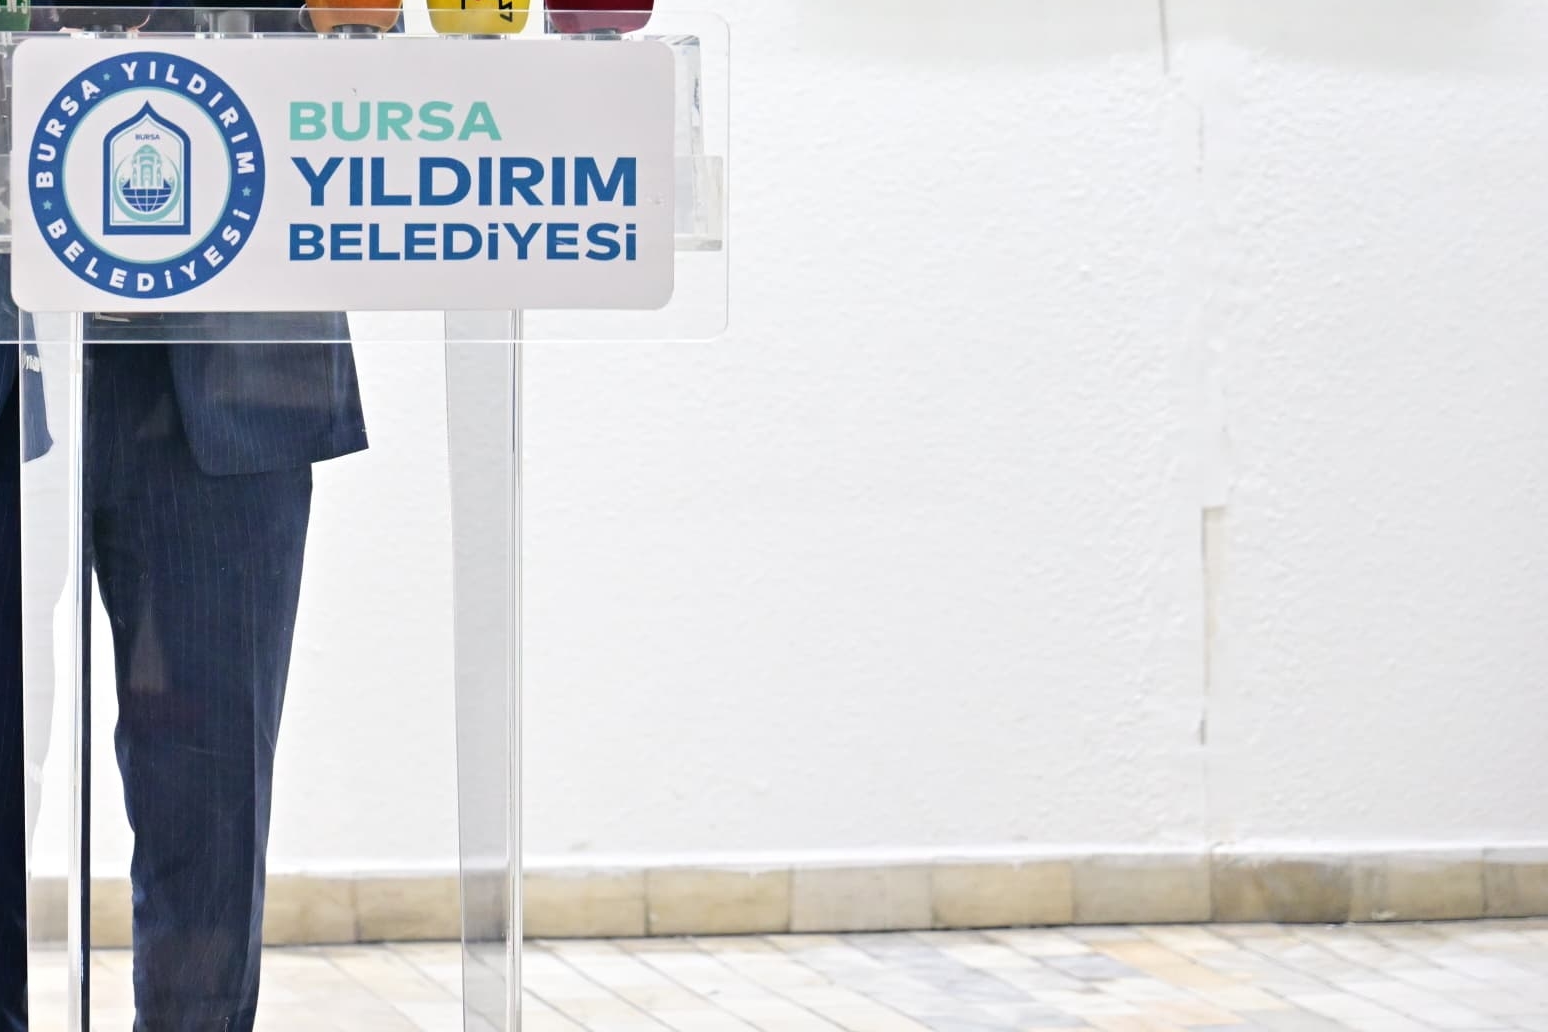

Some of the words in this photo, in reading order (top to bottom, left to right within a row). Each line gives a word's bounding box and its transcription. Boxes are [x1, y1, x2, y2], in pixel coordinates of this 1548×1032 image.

[35, 79, 101, 188] BURSA
[121, 61, 255, 174] YILDIRIM
[134, 133, 160, 141] BURSA
[289, 101, 502, 141] BURSA
[290, 156, 637, 206] YILDIRIM
